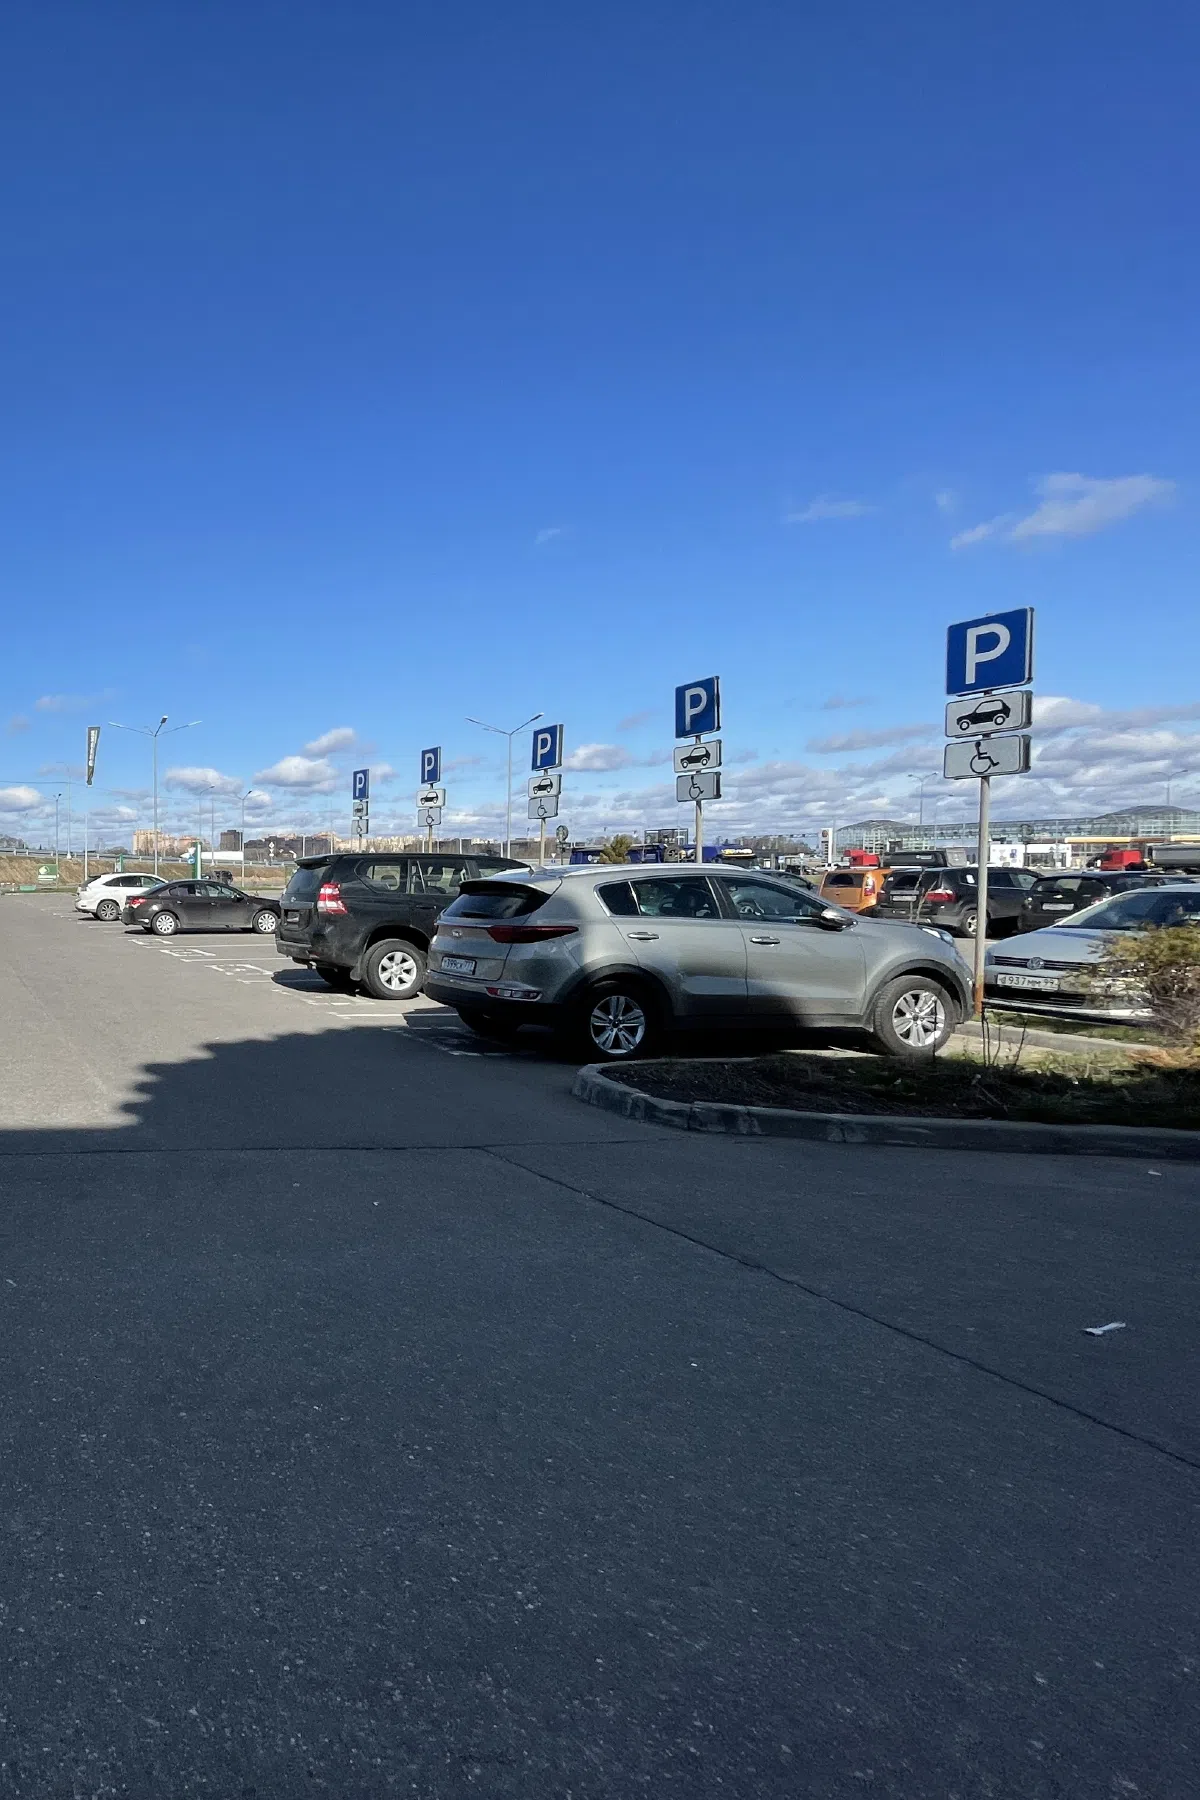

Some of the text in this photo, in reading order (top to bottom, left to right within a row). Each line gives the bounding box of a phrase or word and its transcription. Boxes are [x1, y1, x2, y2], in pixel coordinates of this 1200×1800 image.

[965, 623, 1011, 684] P
[685, 687, 708, 731] P
[424, 753, 435, 781] P
[537, 733, 552, 767] P
[356, 773, 365, 797] P
